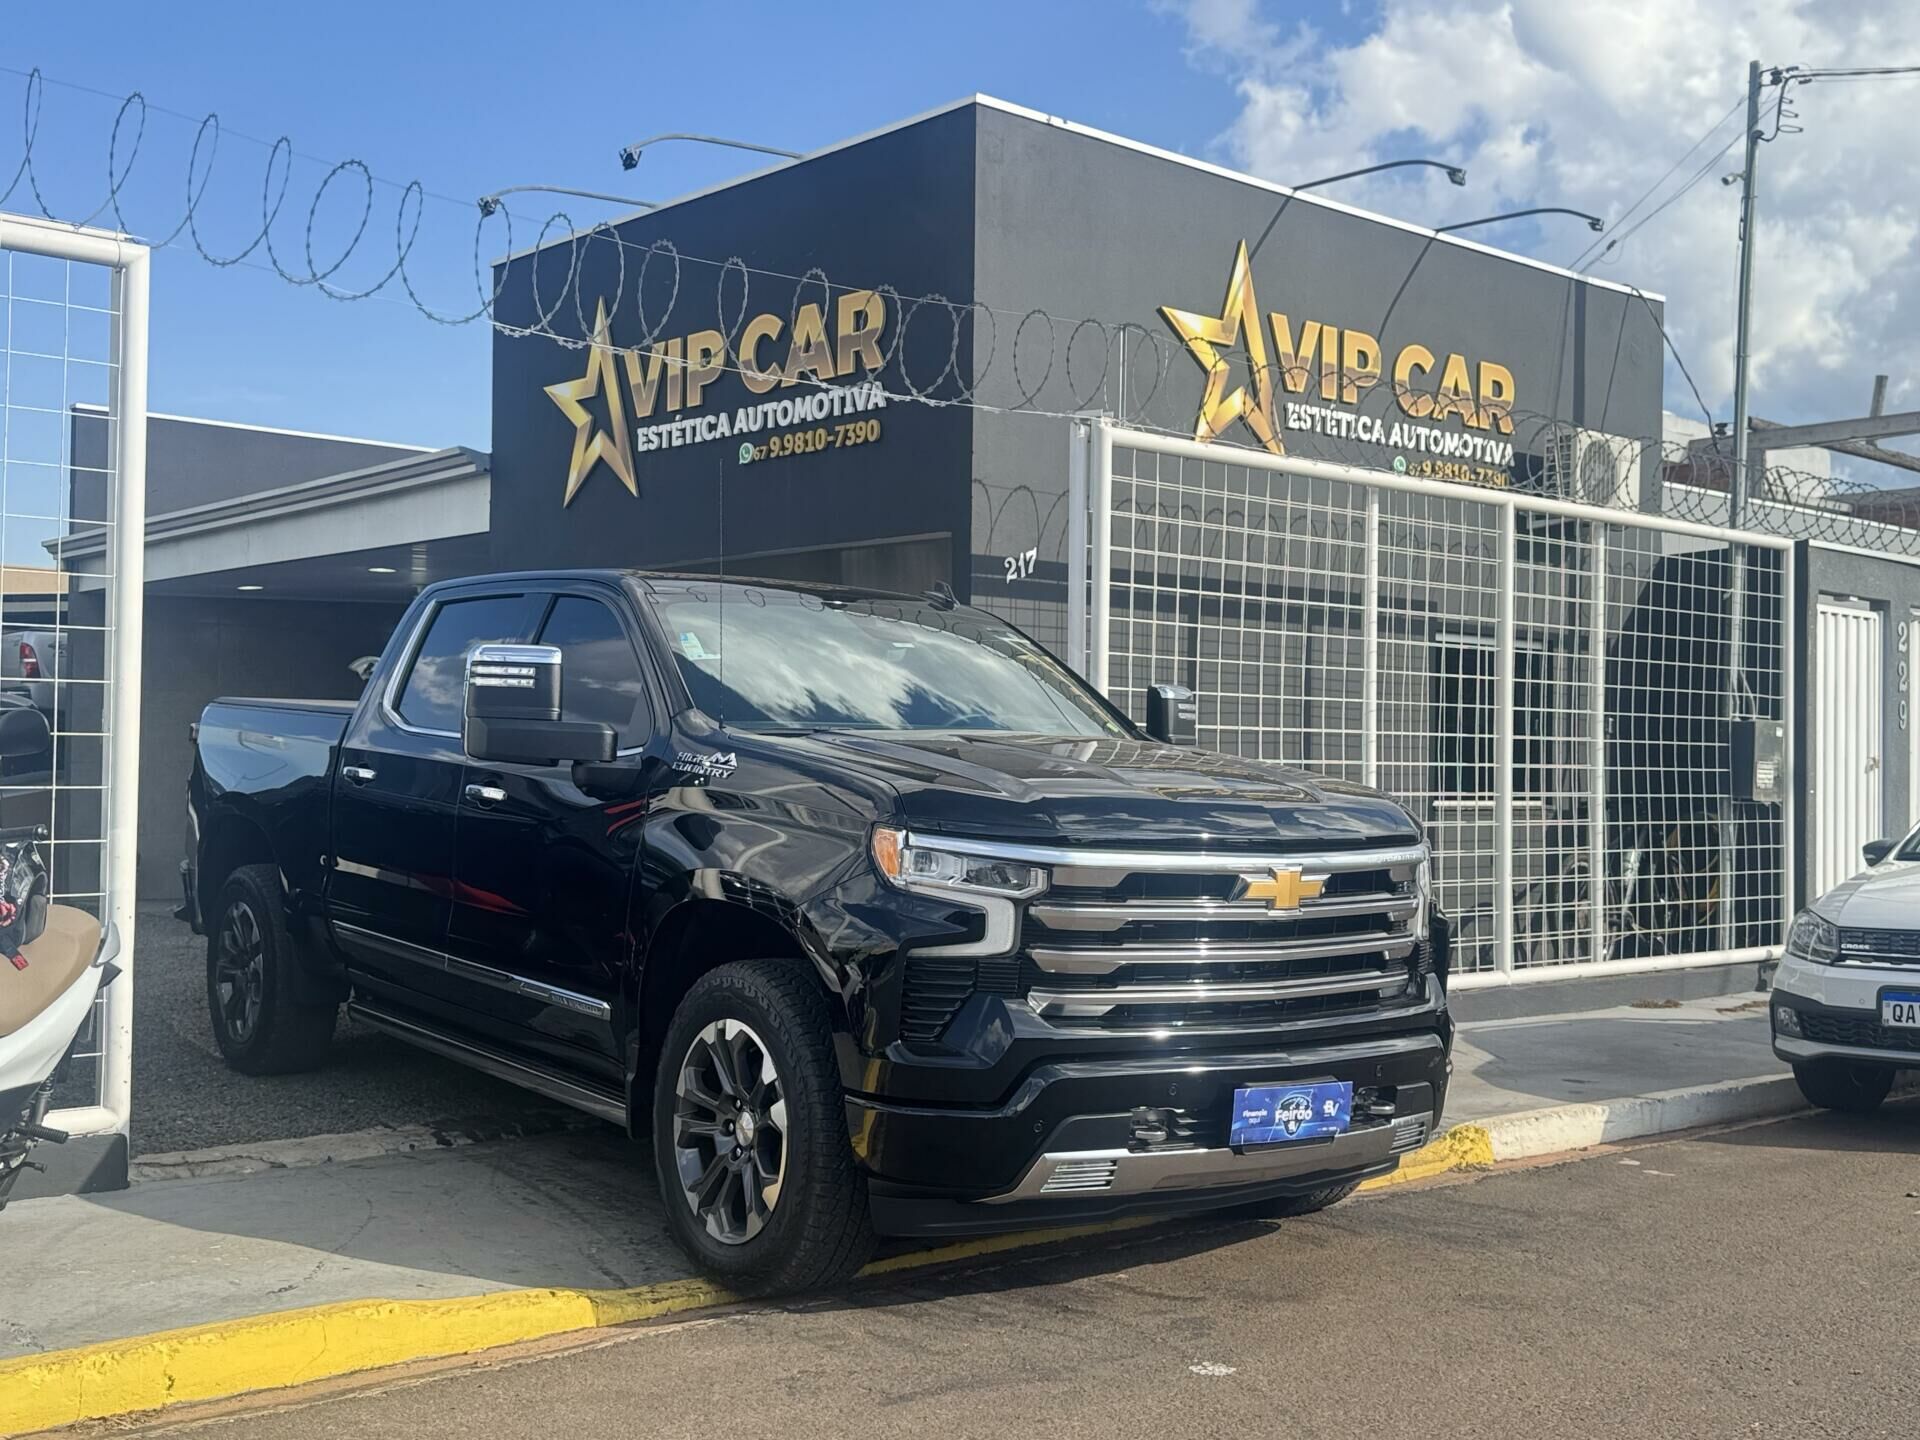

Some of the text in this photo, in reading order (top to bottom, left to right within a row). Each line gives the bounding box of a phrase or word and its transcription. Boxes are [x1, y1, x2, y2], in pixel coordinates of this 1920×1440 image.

[623, 289, 886, 418] VIP CAR
[1268, 312, 1515, 434] VIP CAR
[637, 381, 887, 452] ESTÉTICA AUTOMOTIVA
[769, 419, 881, 458] 9.9810-7390
[1286, 402, 1515, 467] ESTÉTICA AUTOMOTIVA
[1004, 546, 1038, 584] 217
[1892, 1003, 1920, 1024] QA
[1274, 1105, 1313, 1123] Feirão
